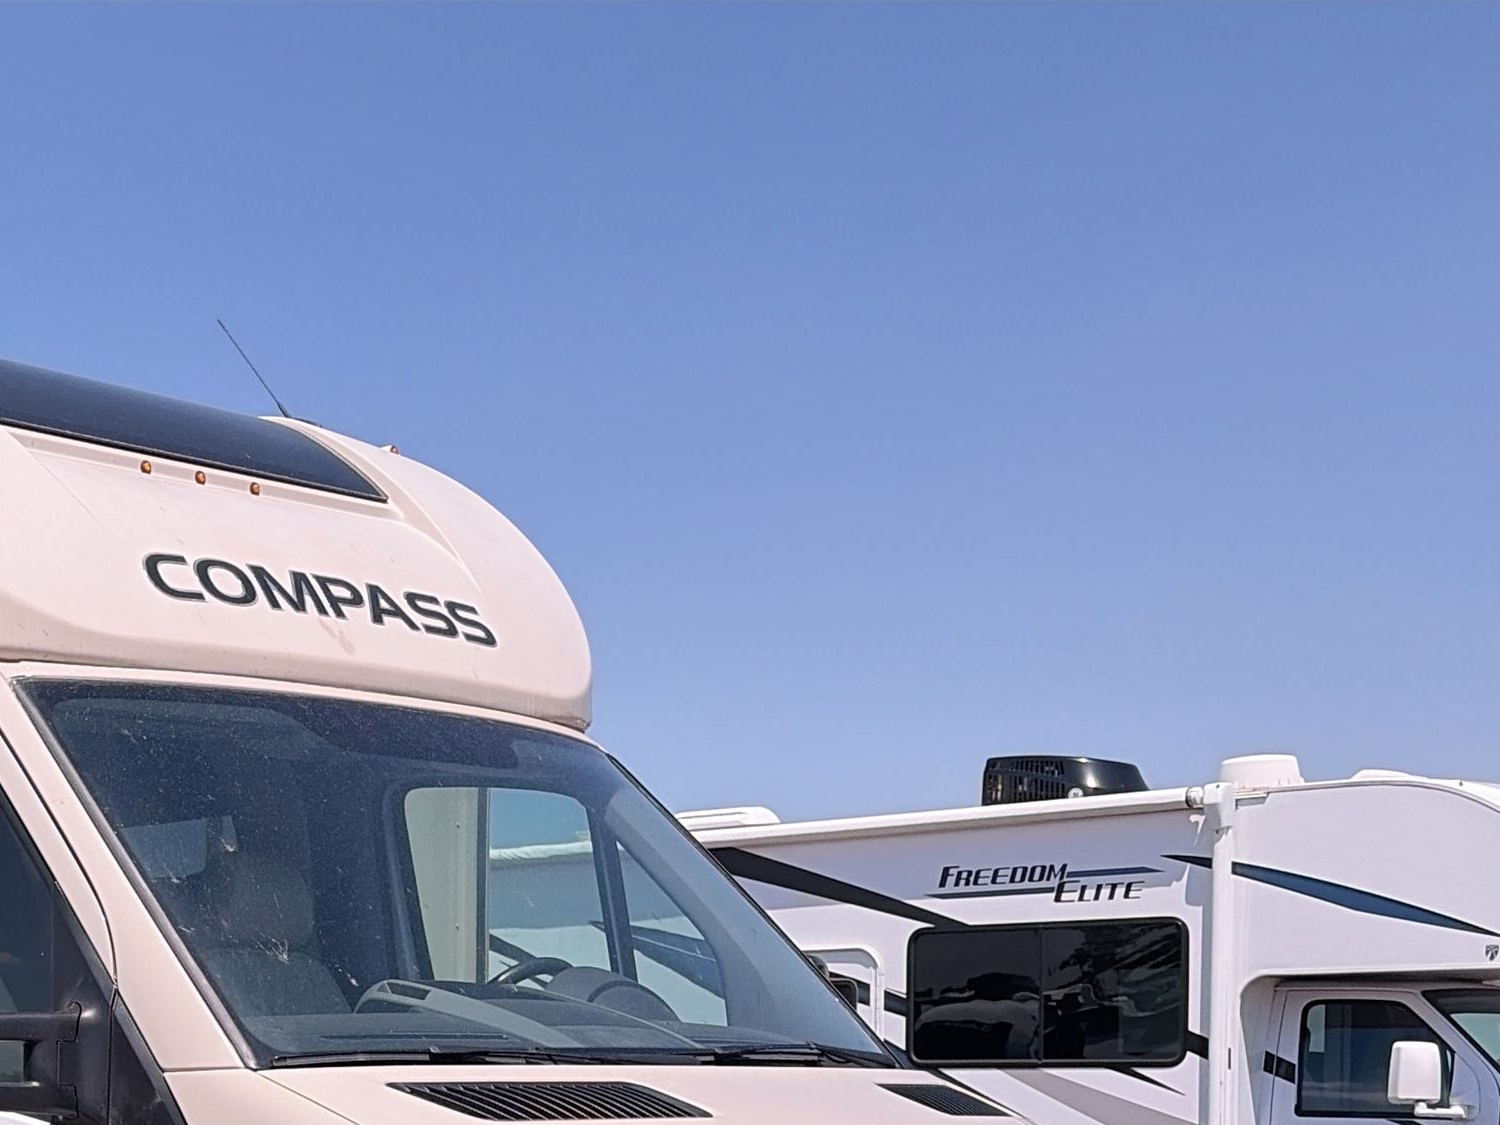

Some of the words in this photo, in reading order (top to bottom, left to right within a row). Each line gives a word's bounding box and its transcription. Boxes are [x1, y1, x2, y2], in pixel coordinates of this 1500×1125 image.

[143, 552, 499, 648] COMPASS
[938, 862, 1069, 889] FREEDOM
[1053, 880, 1146, 904] ELITE
